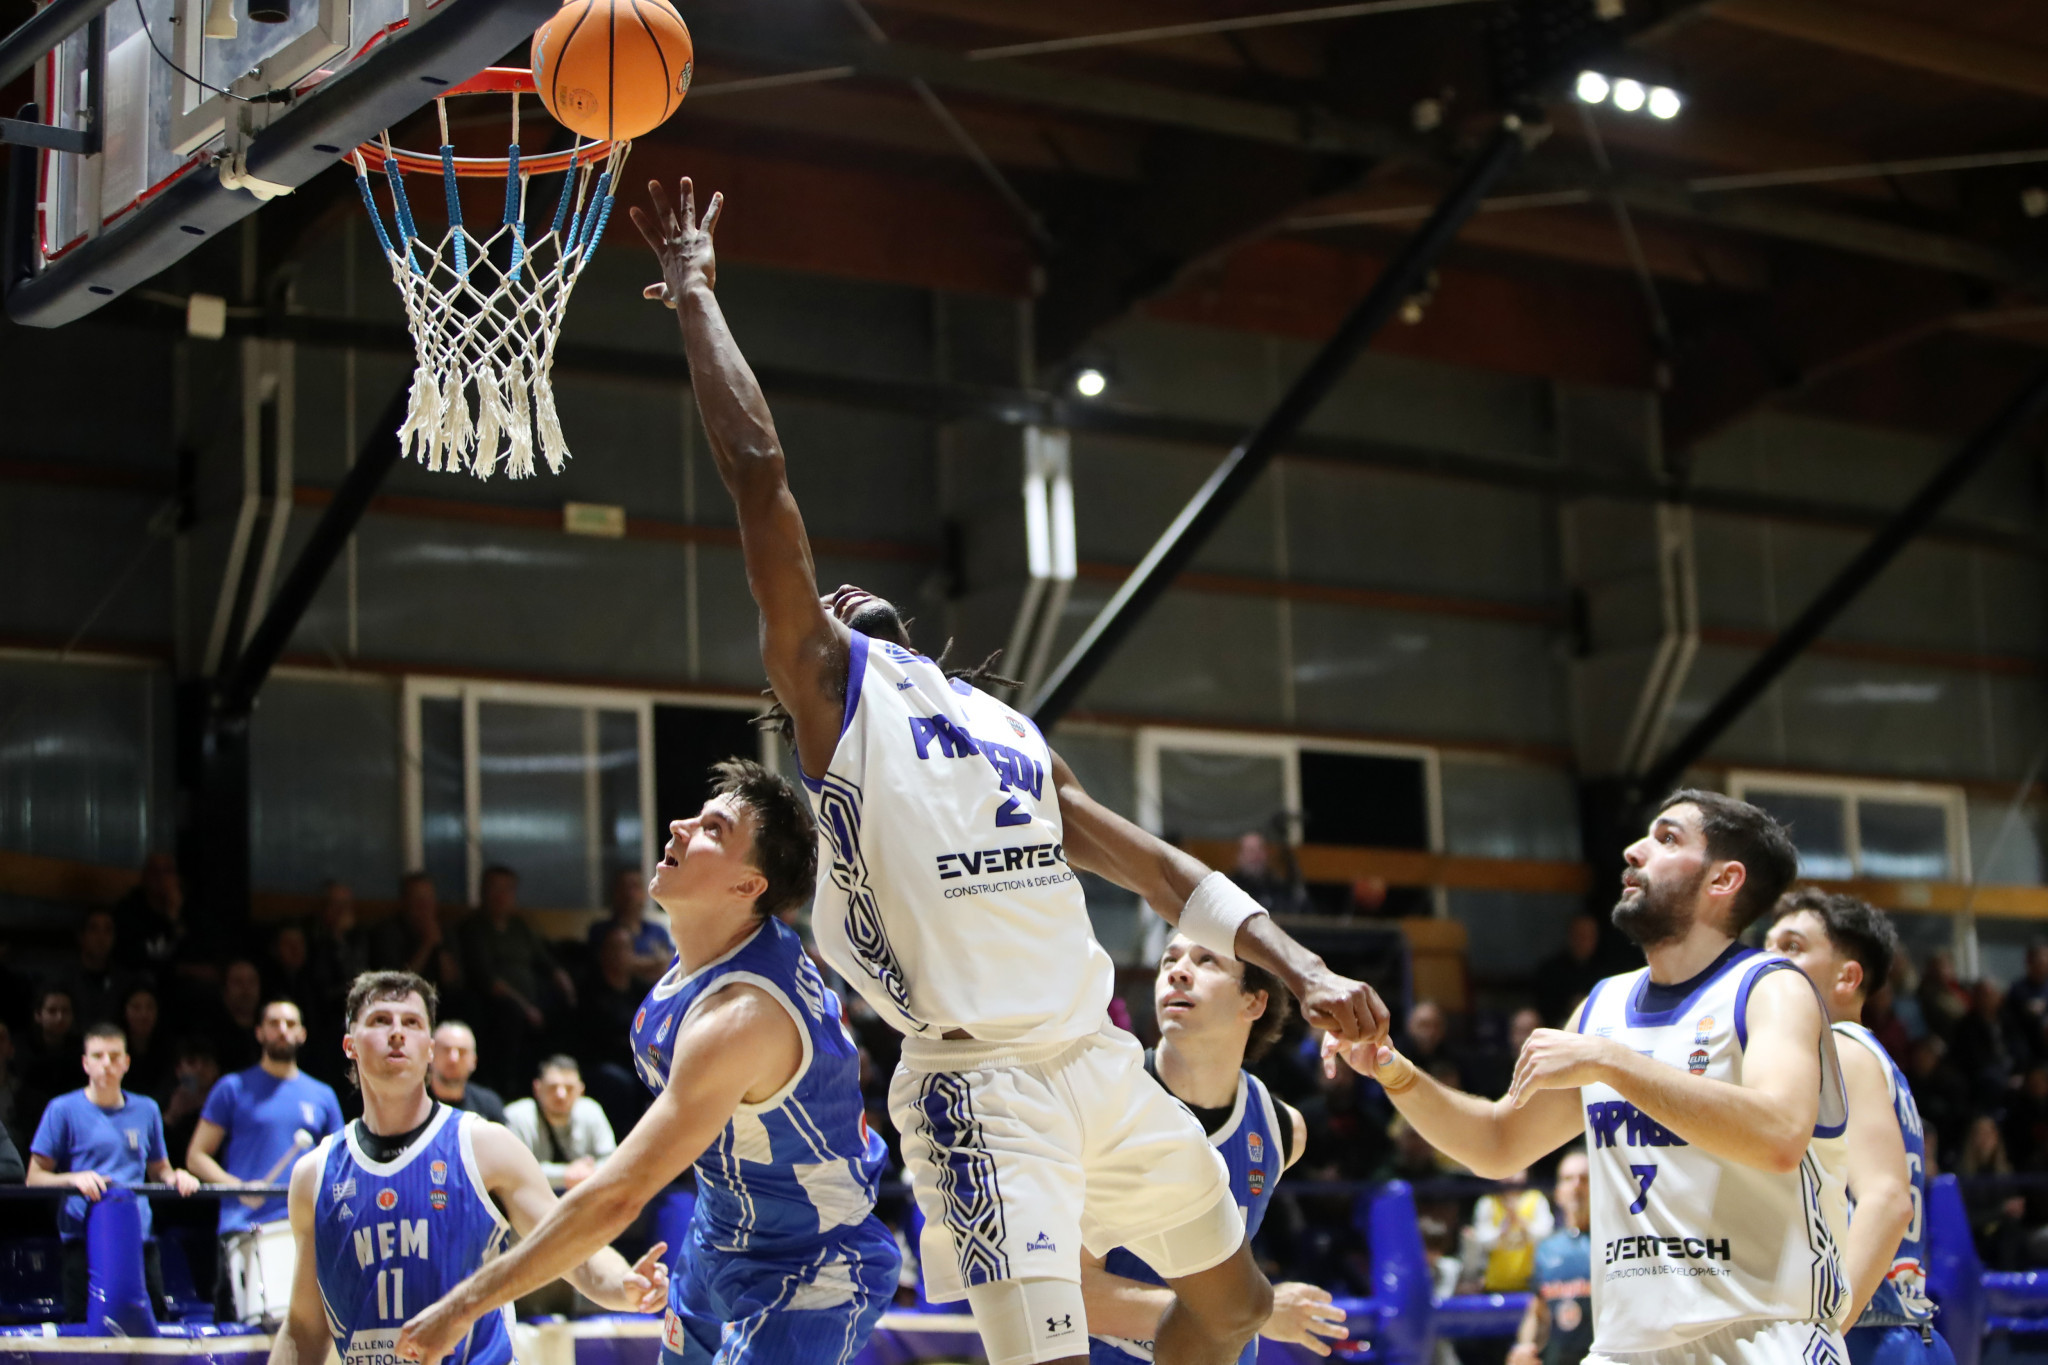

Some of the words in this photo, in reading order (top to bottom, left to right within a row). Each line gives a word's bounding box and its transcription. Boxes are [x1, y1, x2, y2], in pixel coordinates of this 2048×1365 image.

[944, 880, 1025, 899] CONSTRUCTION
[1027, 878, 1034, 888] &
[1630, 1164, 1658, 1216] 7
[353, 1219, 429, 1270] NEM
[1605, 1234, 1731, 1265] EVERTECH
[1652, 1266, 1658, 1275] &
[1658, 1265, 1731, 1278] DEVELOPMENT
[377, 1268, 404, 1320] 11
